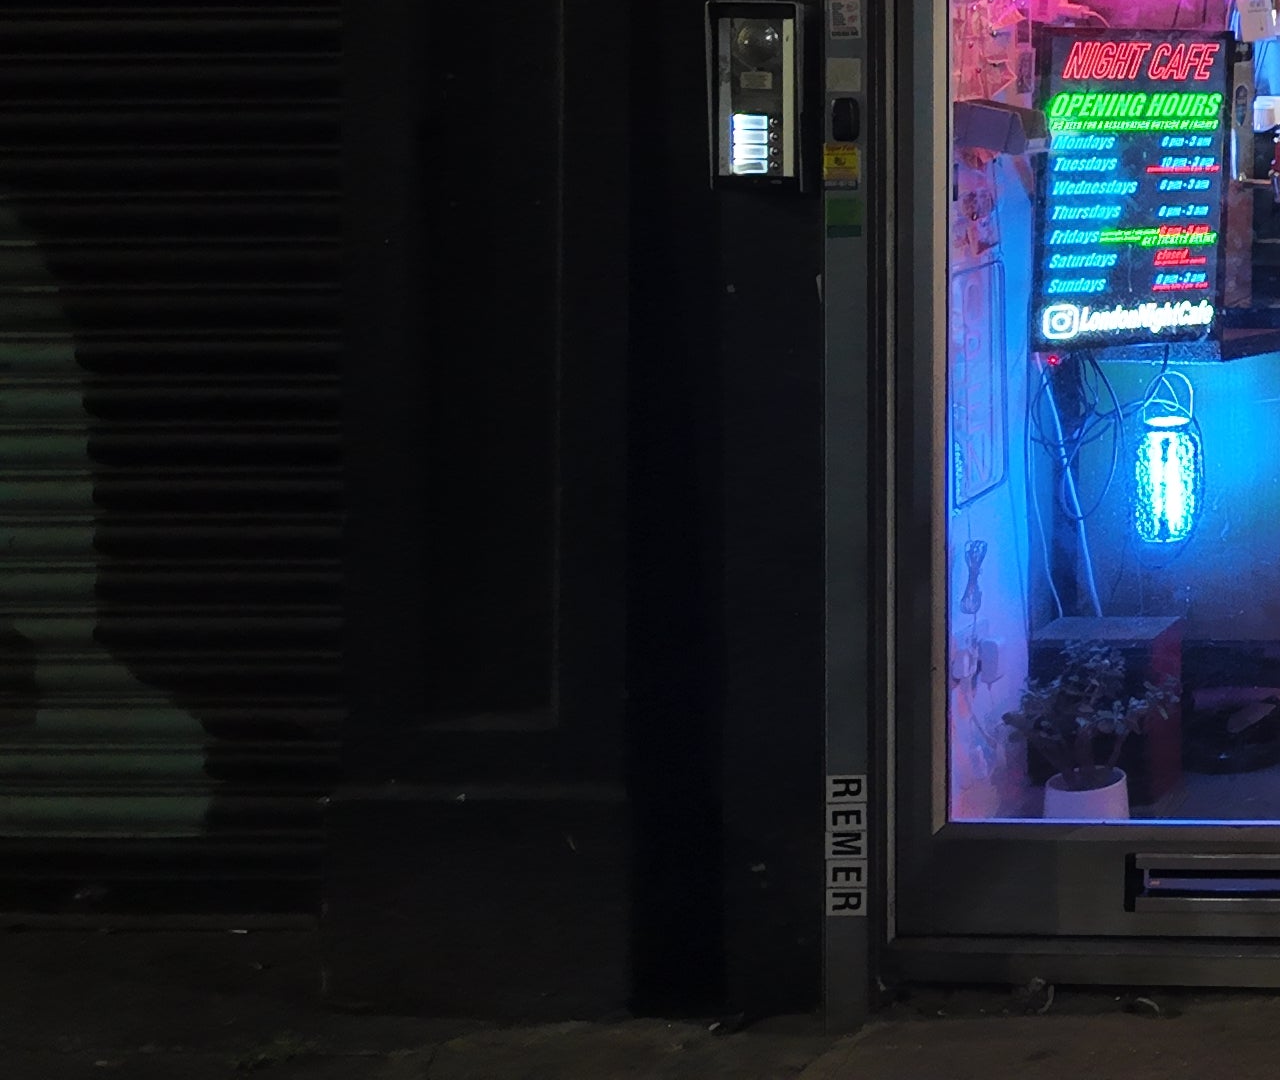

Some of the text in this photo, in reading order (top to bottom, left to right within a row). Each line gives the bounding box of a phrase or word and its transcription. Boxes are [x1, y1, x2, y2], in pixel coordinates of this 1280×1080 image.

[1062, 41, 1220, 81] NIGHT CAFE
[1050, 92, 1223, 118] OPENING HOURS
[1053, 135, 1116, 151] Mondays
[1053, 156, 1118, 172] Tuesdays
[1052, 180, 1138, 196] Wednesdays
[1052, 204, 1122, 220] Thursdays
[1049, 229, 1100, 245] Fridays
[1049, 253, 1118, 269] Saturdays
[1048, 278, 1107, 294] Sundays
[1080, 300, 1214, 334] LondonNightCafe
[831, 778, 862, 911] REMER
